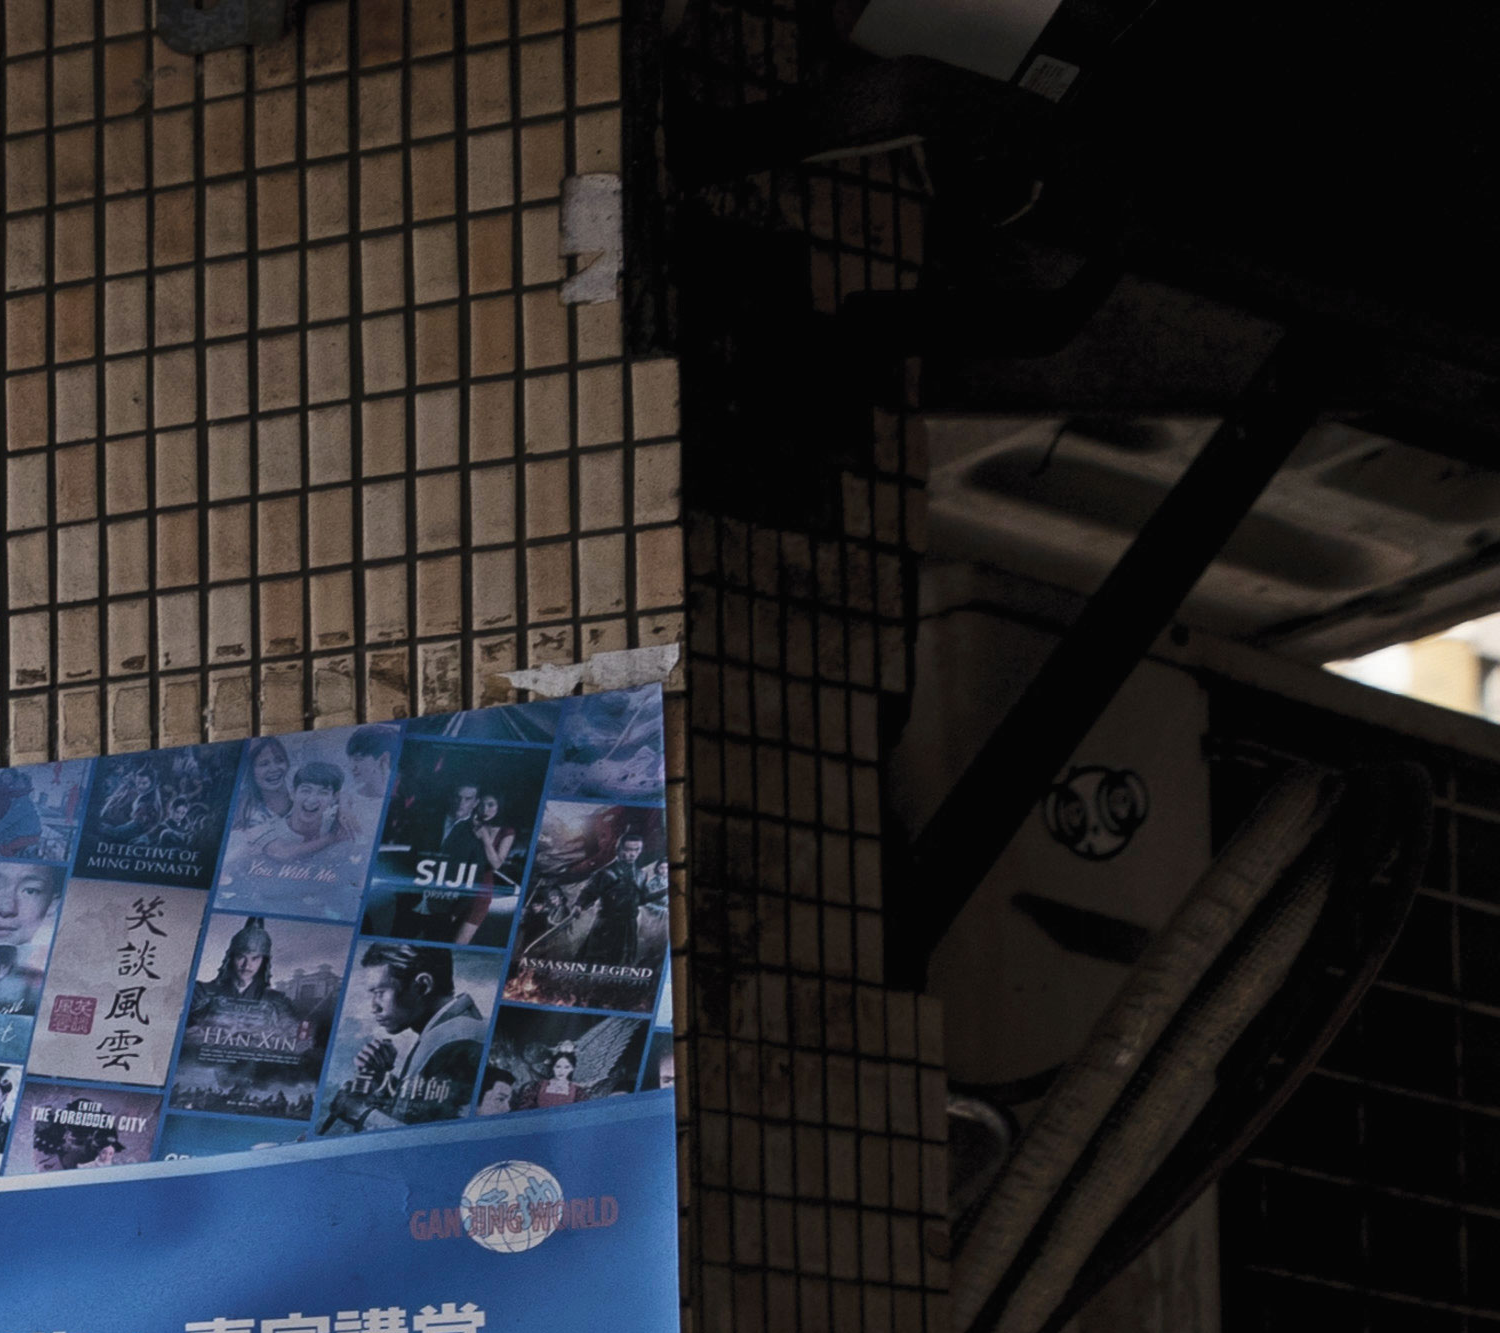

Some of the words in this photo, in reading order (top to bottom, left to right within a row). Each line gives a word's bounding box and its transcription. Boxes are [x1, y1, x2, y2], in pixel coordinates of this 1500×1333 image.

[97, 842, 173, 860] DETECTIVE
[179, 849, 200, 862] OF
[87, 857, 133, 872] MING
[134, 861, 202, 877] DYNASTY
[249, 861, 273, 878] You
[277, 865, 311, 880] With
[314, 868, 338, 883] Me
[414, 860, 478, 889] SIJI
[519, 956, 585, 973] ASSASSIN
[591, 964, 653, 979] LEGEND
[96, 895, 168, 1071] 笑談風雲
[203, 1027, 251, 1048] HAN
[257, 1031, 297, 1051] XIN
[78, 1101, 102, 1114] ENTER
[30, 1106, 51, 1122] THE
[53, 1108, 116, 1130] FORBIDDEN
[117, 1116, 147, 1133] CITY
[530, 1196, 619, 1233] WORLD
